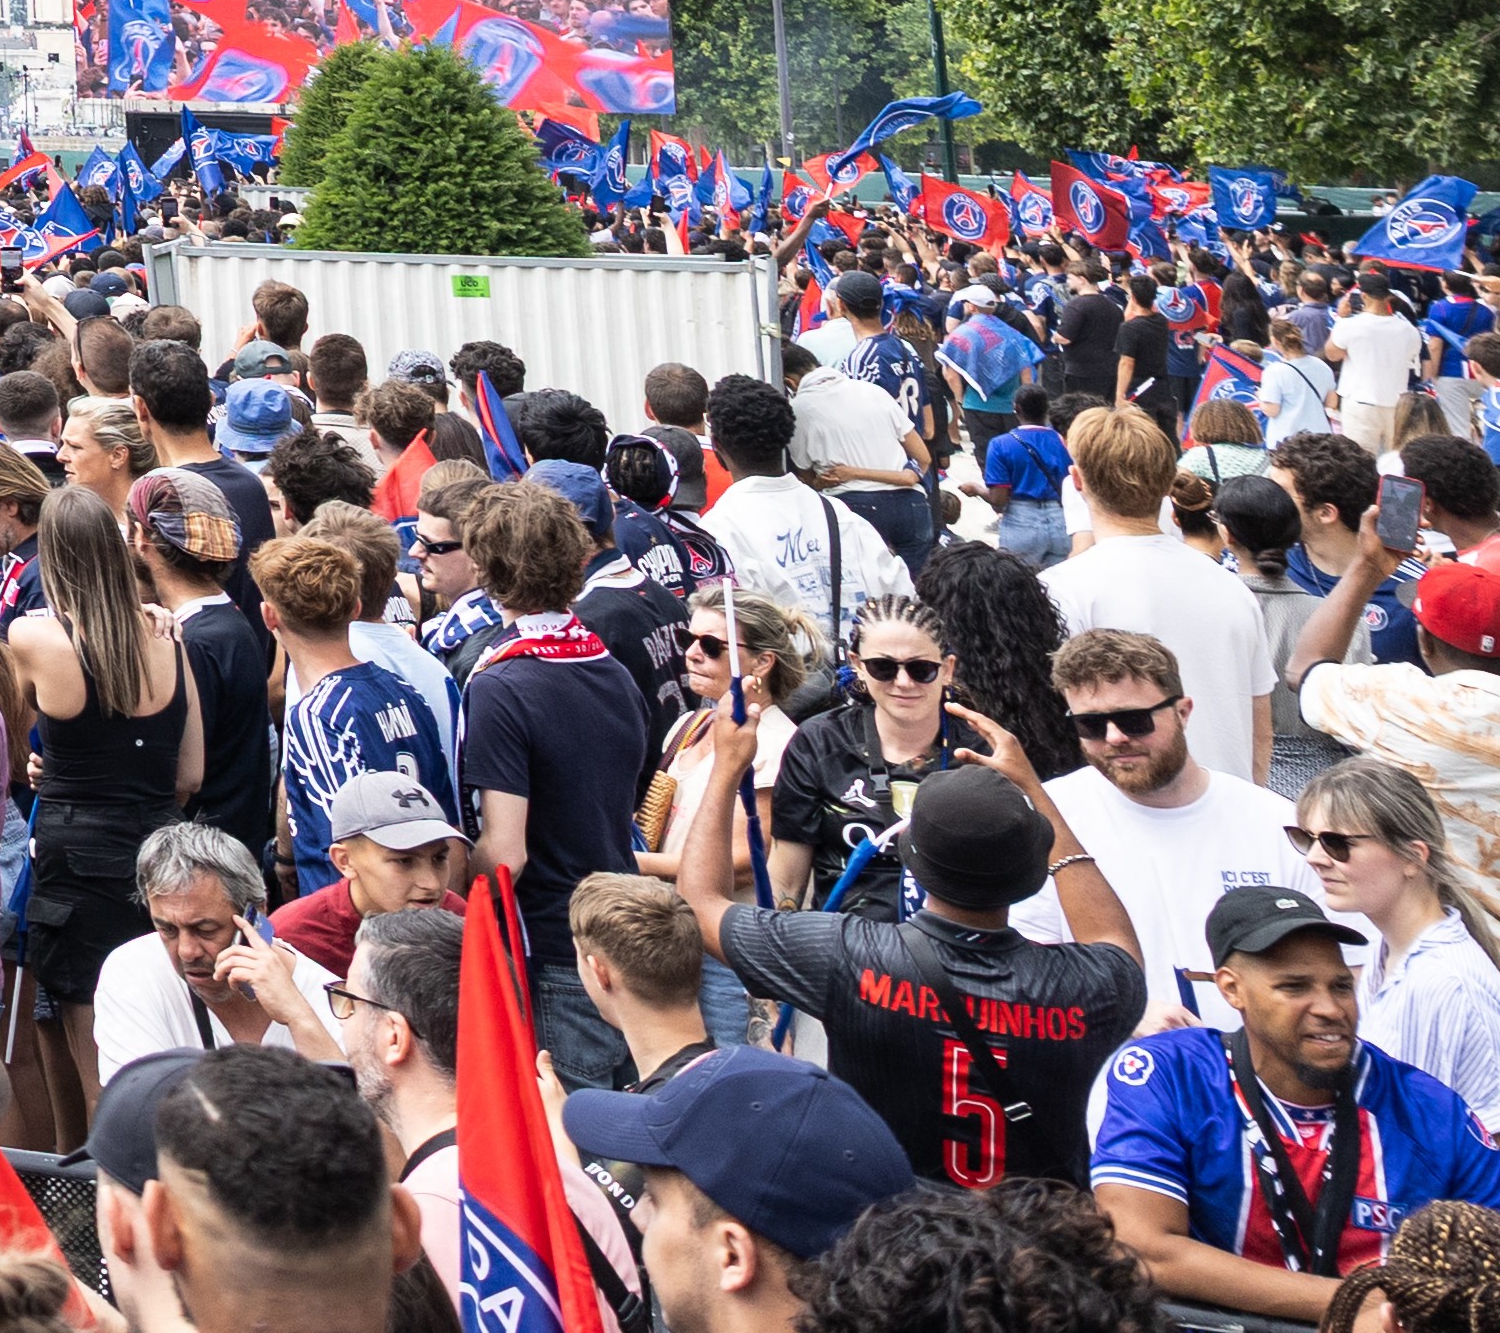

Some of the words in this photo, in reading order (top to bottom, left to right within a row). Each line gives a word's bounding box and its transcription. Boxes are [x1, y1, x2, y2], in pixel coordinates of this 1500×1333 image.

[1221, 869, 1240, 884] ICI
[1243, 871, 1271, 885] C'EST
[859, 968, 1087, 1041] MARUINHOS
[942, 1038, 1008, 1190] 5
